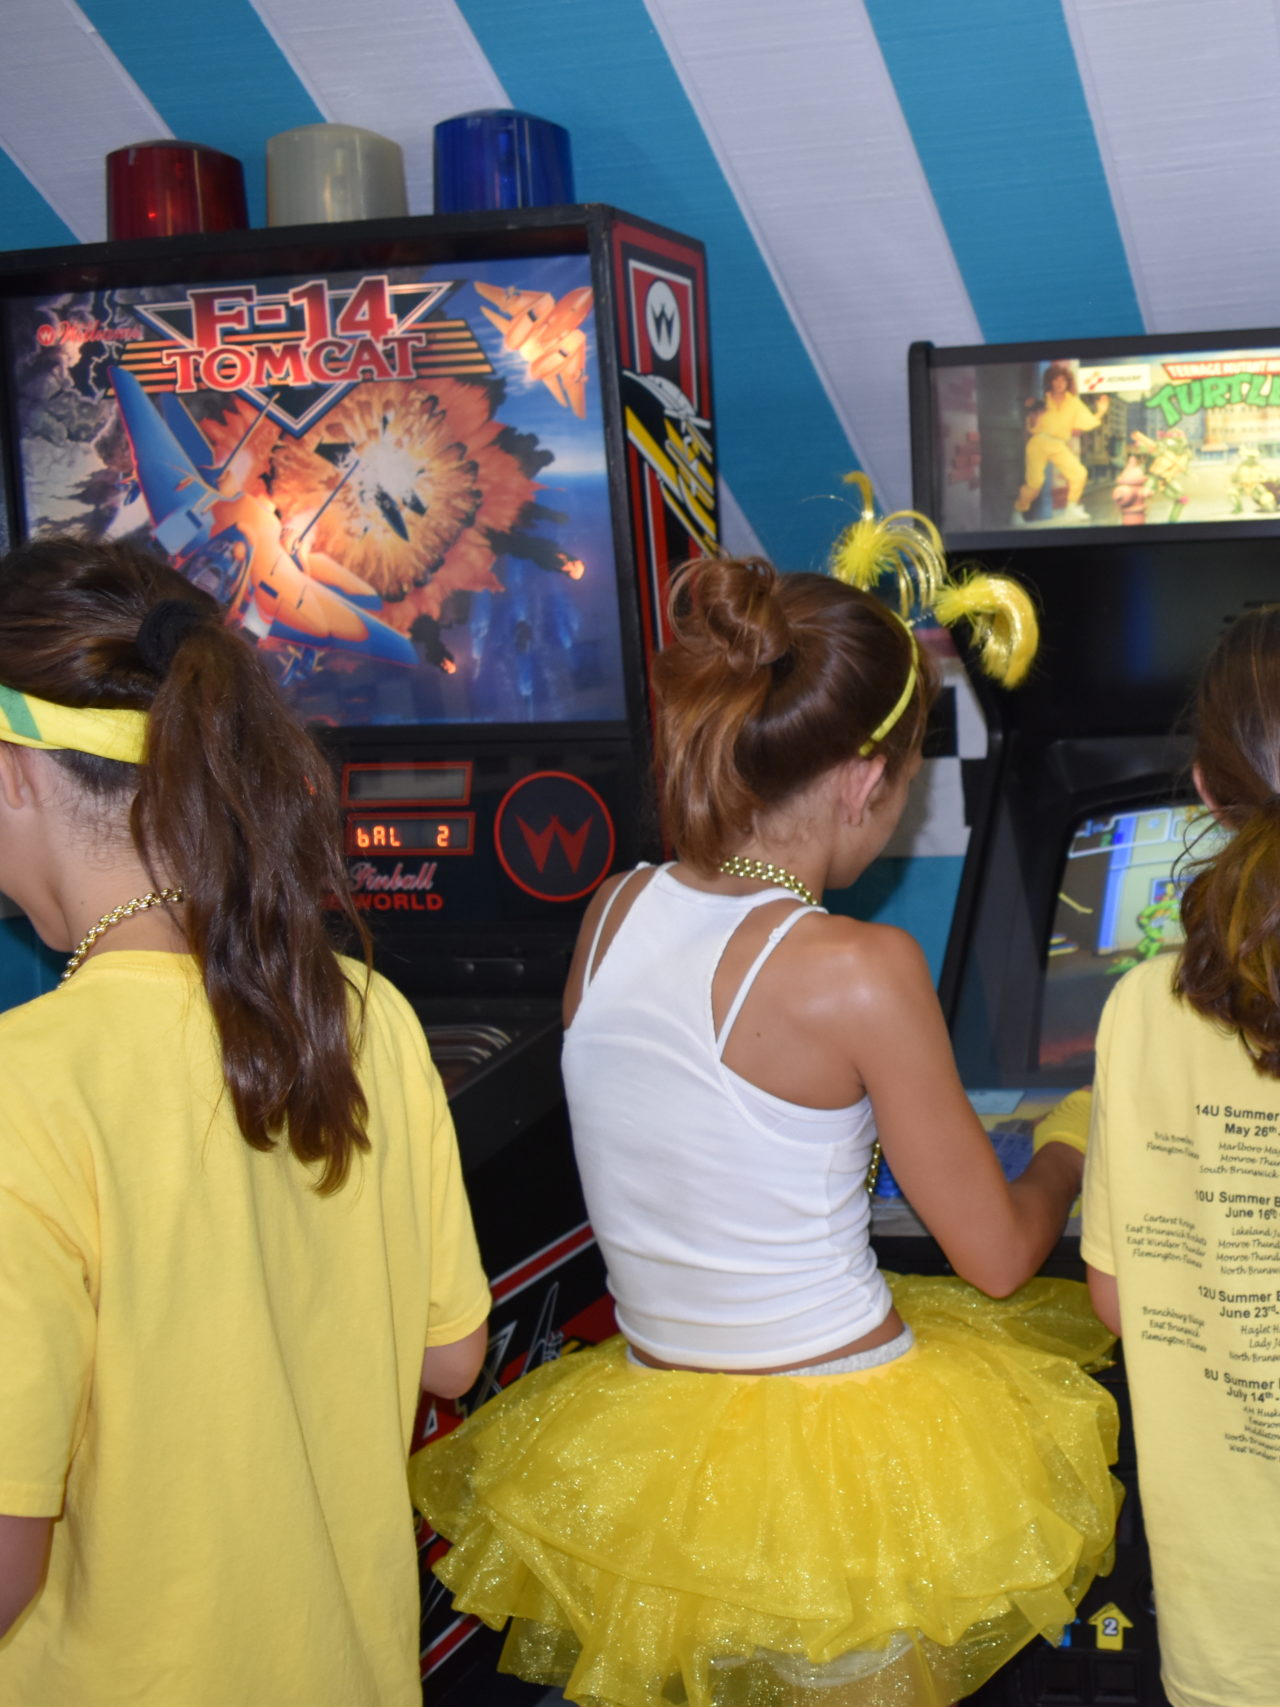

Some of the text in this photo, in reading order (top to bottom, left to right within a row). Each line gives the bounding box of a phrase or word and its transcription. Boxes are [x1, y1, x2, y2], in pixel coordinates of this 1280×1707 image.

[187, 275, 398, 352] F-14
[56, 320, 144, 345] Williams
[162, 333, 426, 393] TOMCAT
[436, 825, 450, 848] 2
[514, 814, 594, 875] W
[350, 862, 438, 891] Pinball
[354, 893, 444, 911] WORLD
[1195, 1104, 1219, 1117] 14U
[1224, 1106, 1280, 1122] Summer
[1224, 1123, 1250, 1138] May
[1219, 1142, 1262, 1154] Marlboro
[1220, 1154, 1258, 1165] Monroe
[1200, 1165, 1228, 1175] South
[1229, 1166, 1279, 1179] Brunswick
[1195, 1190, 1214, 1203] 10U
[1219, 1191, 1271, 1206] Summer
[1225, 1207, 1254, 1218] June
[1232, 1226, 1271, 1236] Lakeland
[1218, 1238, 1250, 1248] Monroe
[1216, 1251, 1249, 1262] Monroe
[1220, 1265, 1246, 1275] North
[1198, 1285, 1216, 1300] 12U
[1218, 1290, 1273, 1304] Summer
[1220, 1306, 1251, 1319] June
[1249, 1337, 1271, 1350] Lady
[1229, 1350, 1250, 1362] North
[1204, 1368, 1219, 1381] 8U
[1224, 1372, 1275, 1390] Summer
[1226, 1386, 1248, 1402] July
[1103, 1618, 1119, 1637] 2
